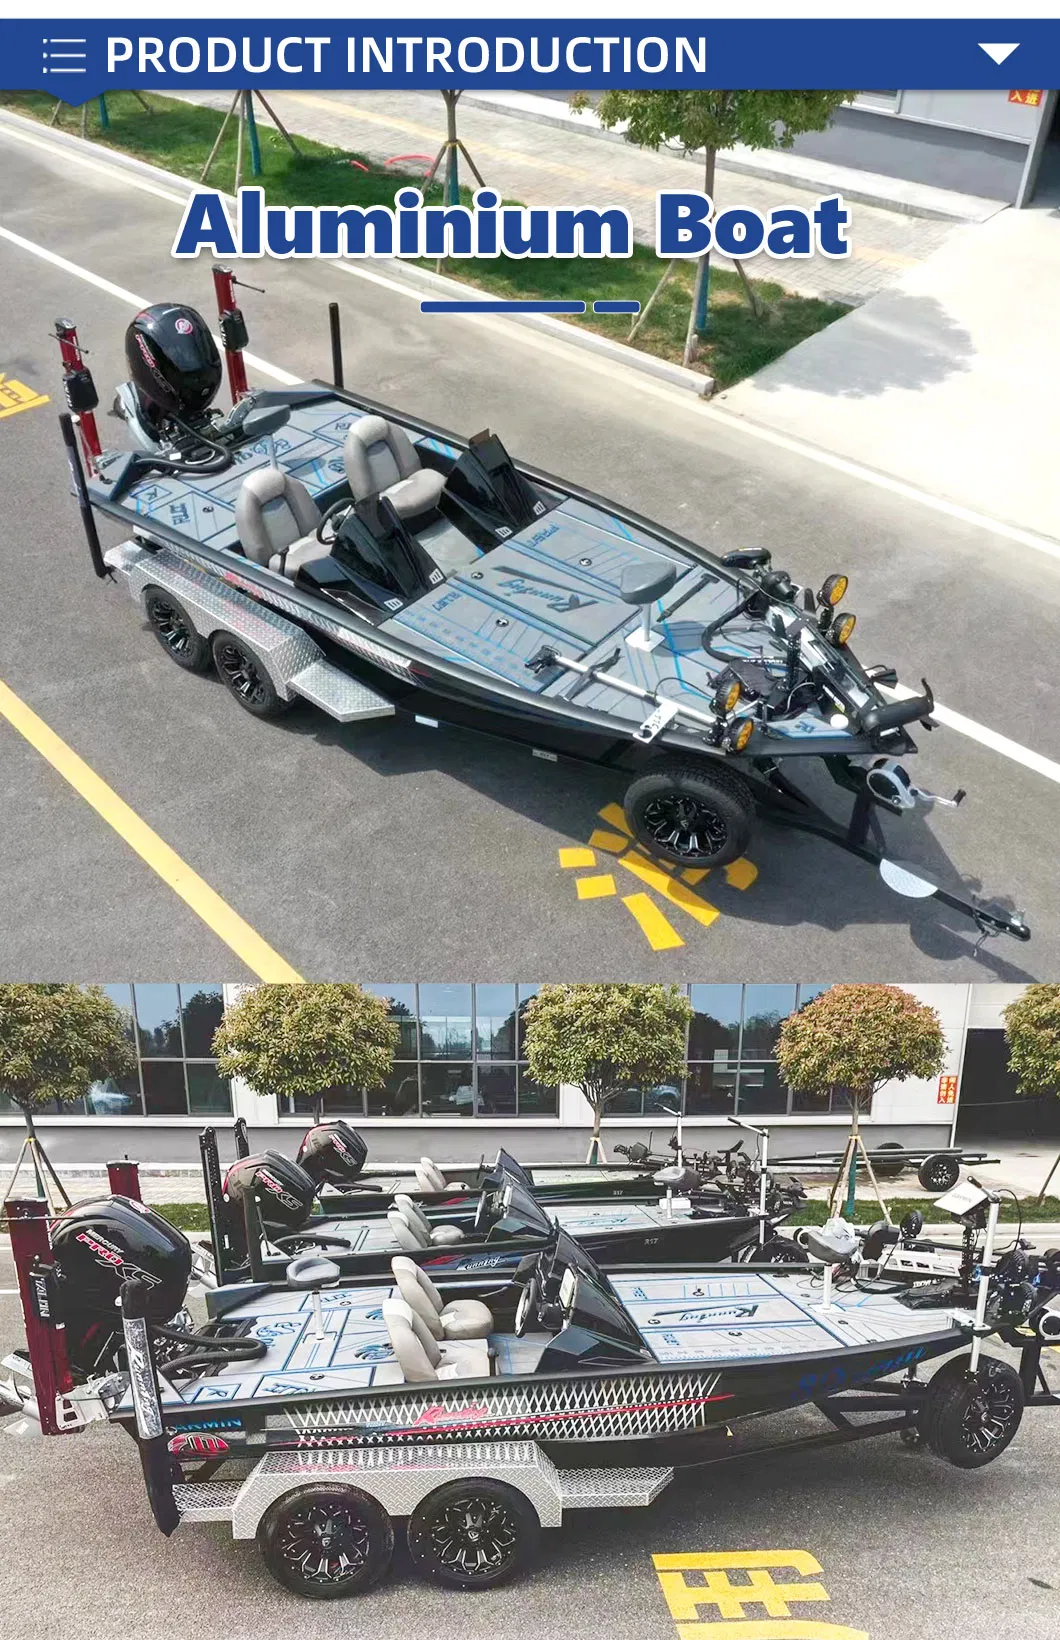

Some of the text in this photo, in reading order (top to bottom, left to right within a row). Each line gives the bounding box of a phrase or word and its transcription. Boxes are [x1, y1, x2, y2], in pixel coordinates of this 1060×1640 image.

[76, 1233, 163, 1291] PRO XS
[85, 1228, 125, 1254] MERCURY
